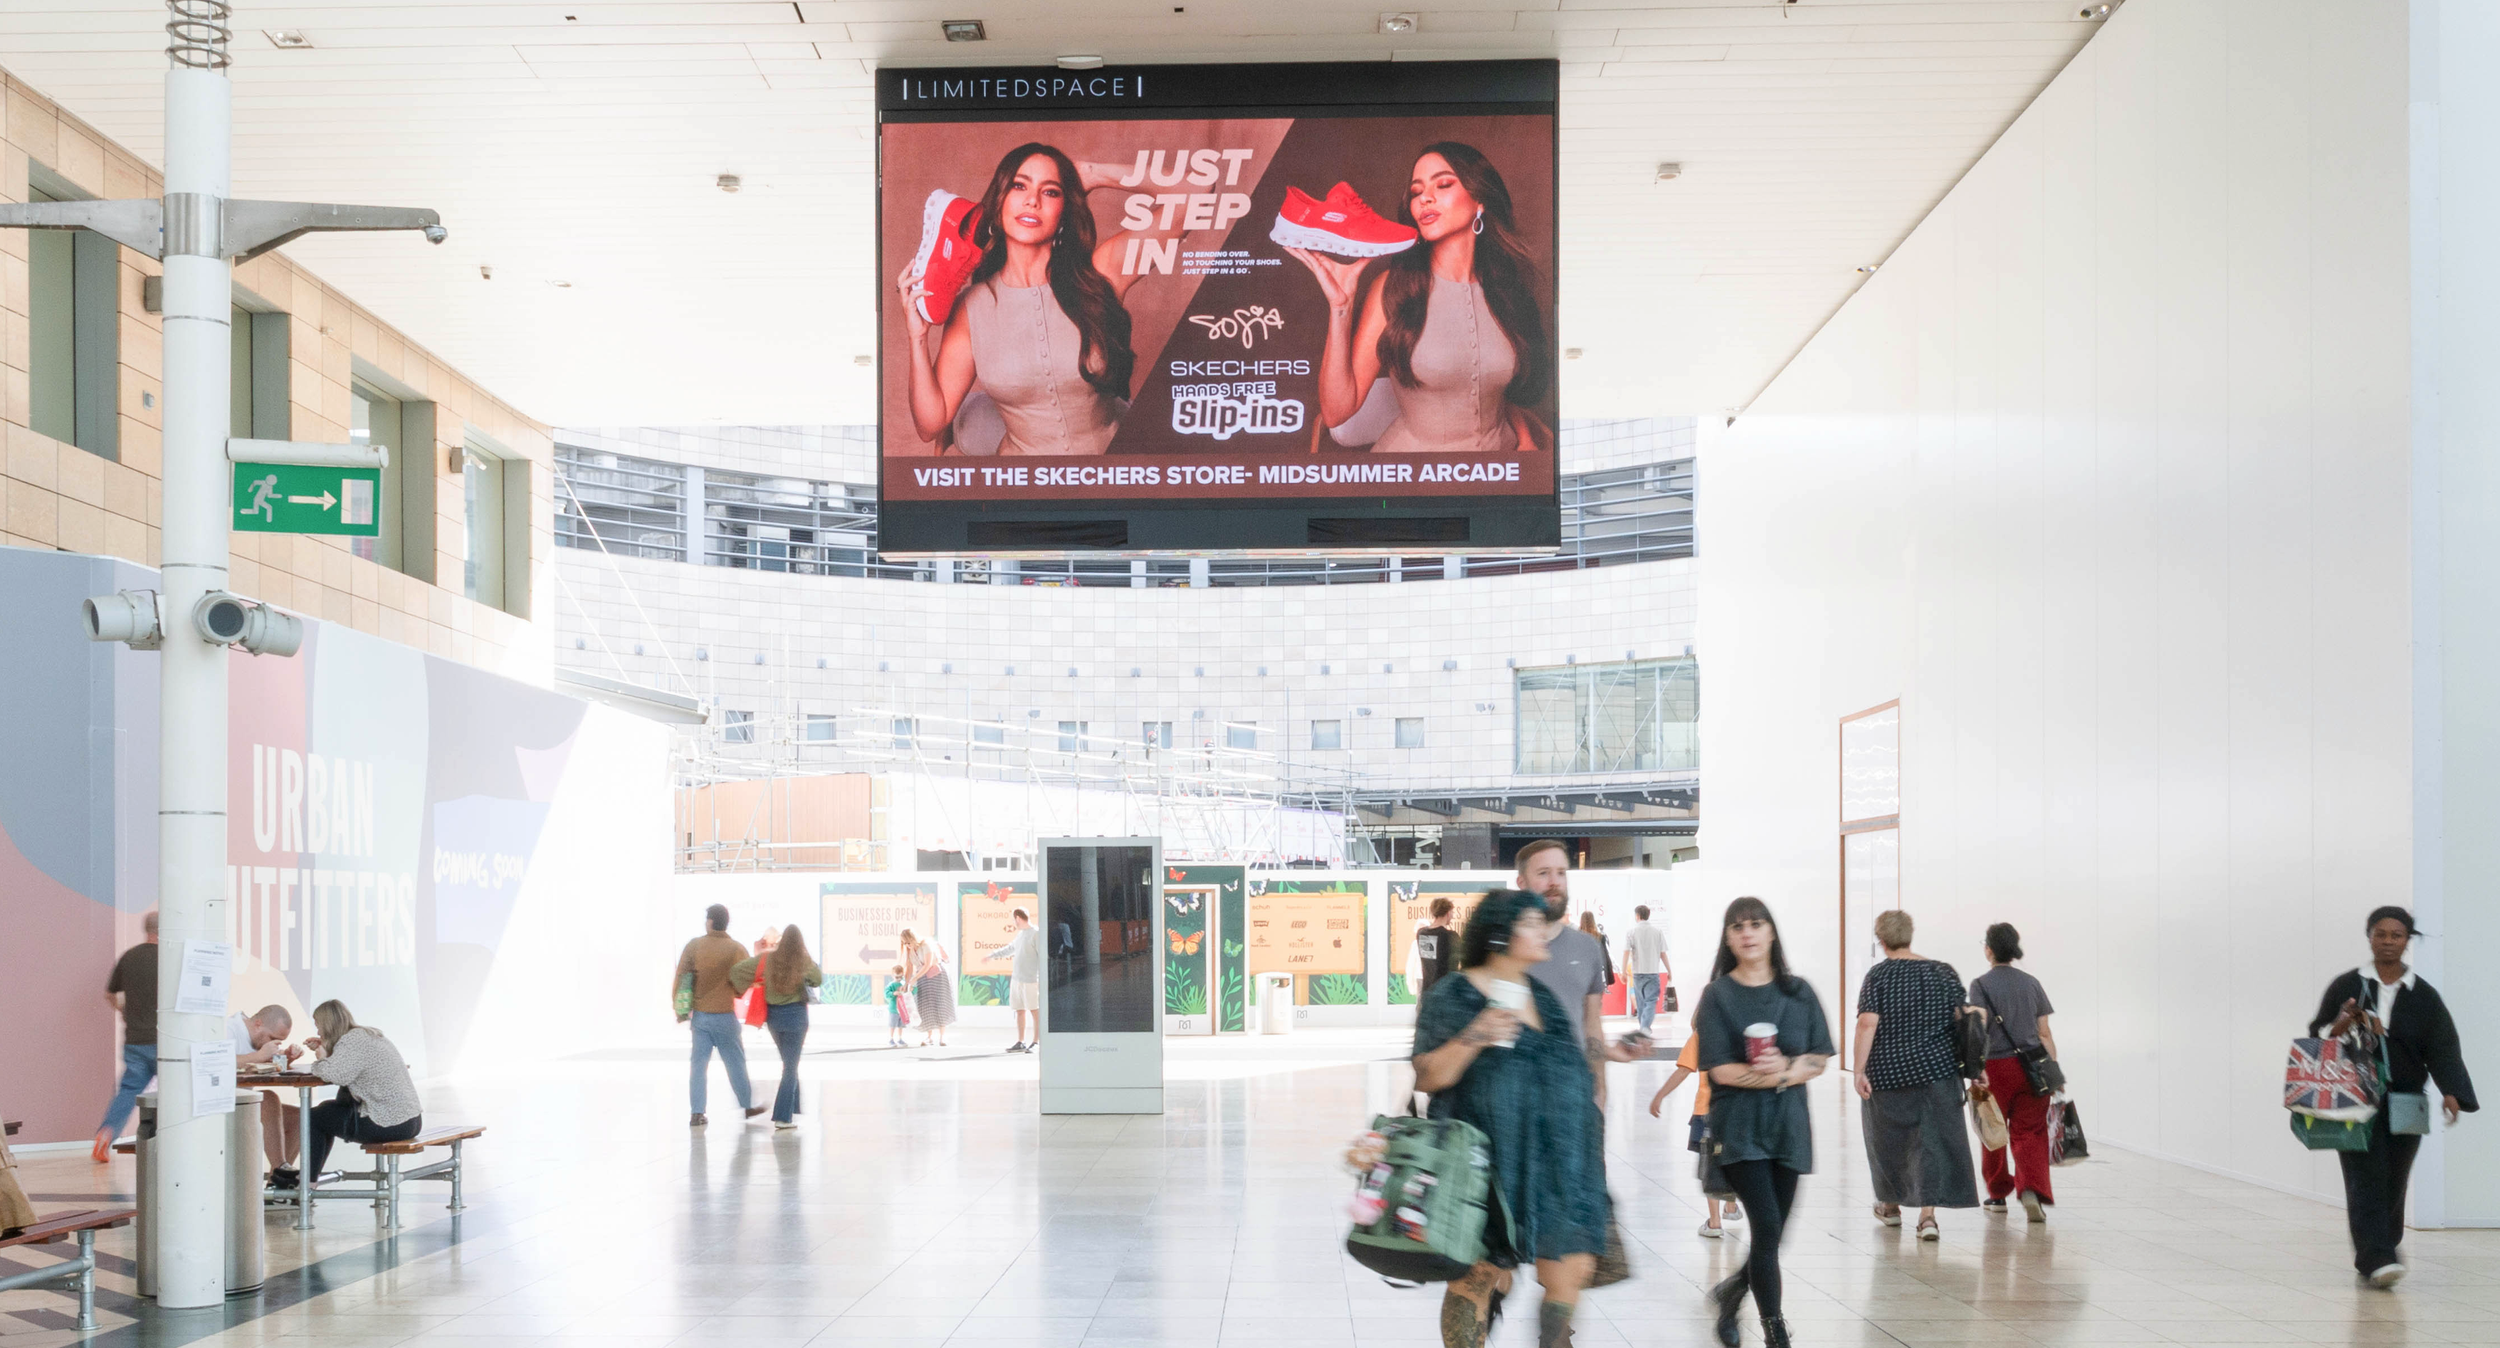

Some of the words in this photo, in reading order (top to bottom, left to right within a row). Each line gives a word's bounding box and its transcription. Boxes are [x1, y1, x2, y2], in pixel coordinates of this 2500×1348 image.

[918, 77, 1124, 99] LIMITEDSPACE
[1119, 149, 1254, 187] JUST
[1120, 193, 1251, 231] STEP
[1121, 238, 1179, 275] IN
[1170, 360, 1311, 376] SKECHERS
[1173, 384, 1230, 399] HANDS
[1233, 381, 1276, 397] FREE
[1176, 398, 1301, 436] Slip-ins
[914, 468, 975, 486] VISIT
[981, 467, 1028, 486] THE
[1034, 466, 1160, 486] SKECHERS
[1166, 466, 1253, 485] STORE-
[1259, 464, 1413, 484] MIDSUMMER
[1418, 463, 1520, 482] ARCADE
[253, 743, 373, 857] URBAN
[433, 845, 489, 889] COMING
[226, 864, 416, 975] UTFITTERS
[838, 907, 892, 921] BUSINESSES
[895, 907, 918, 921] OPEN
[1290, 920, 1308, 929] LEGO
[858, 923, 869, 936] AS
[872, 923, 900, 936] USUAL
[1288, 955, 1314, 963] LANE7
[2299, 1058, 2356, 1081] M&S
